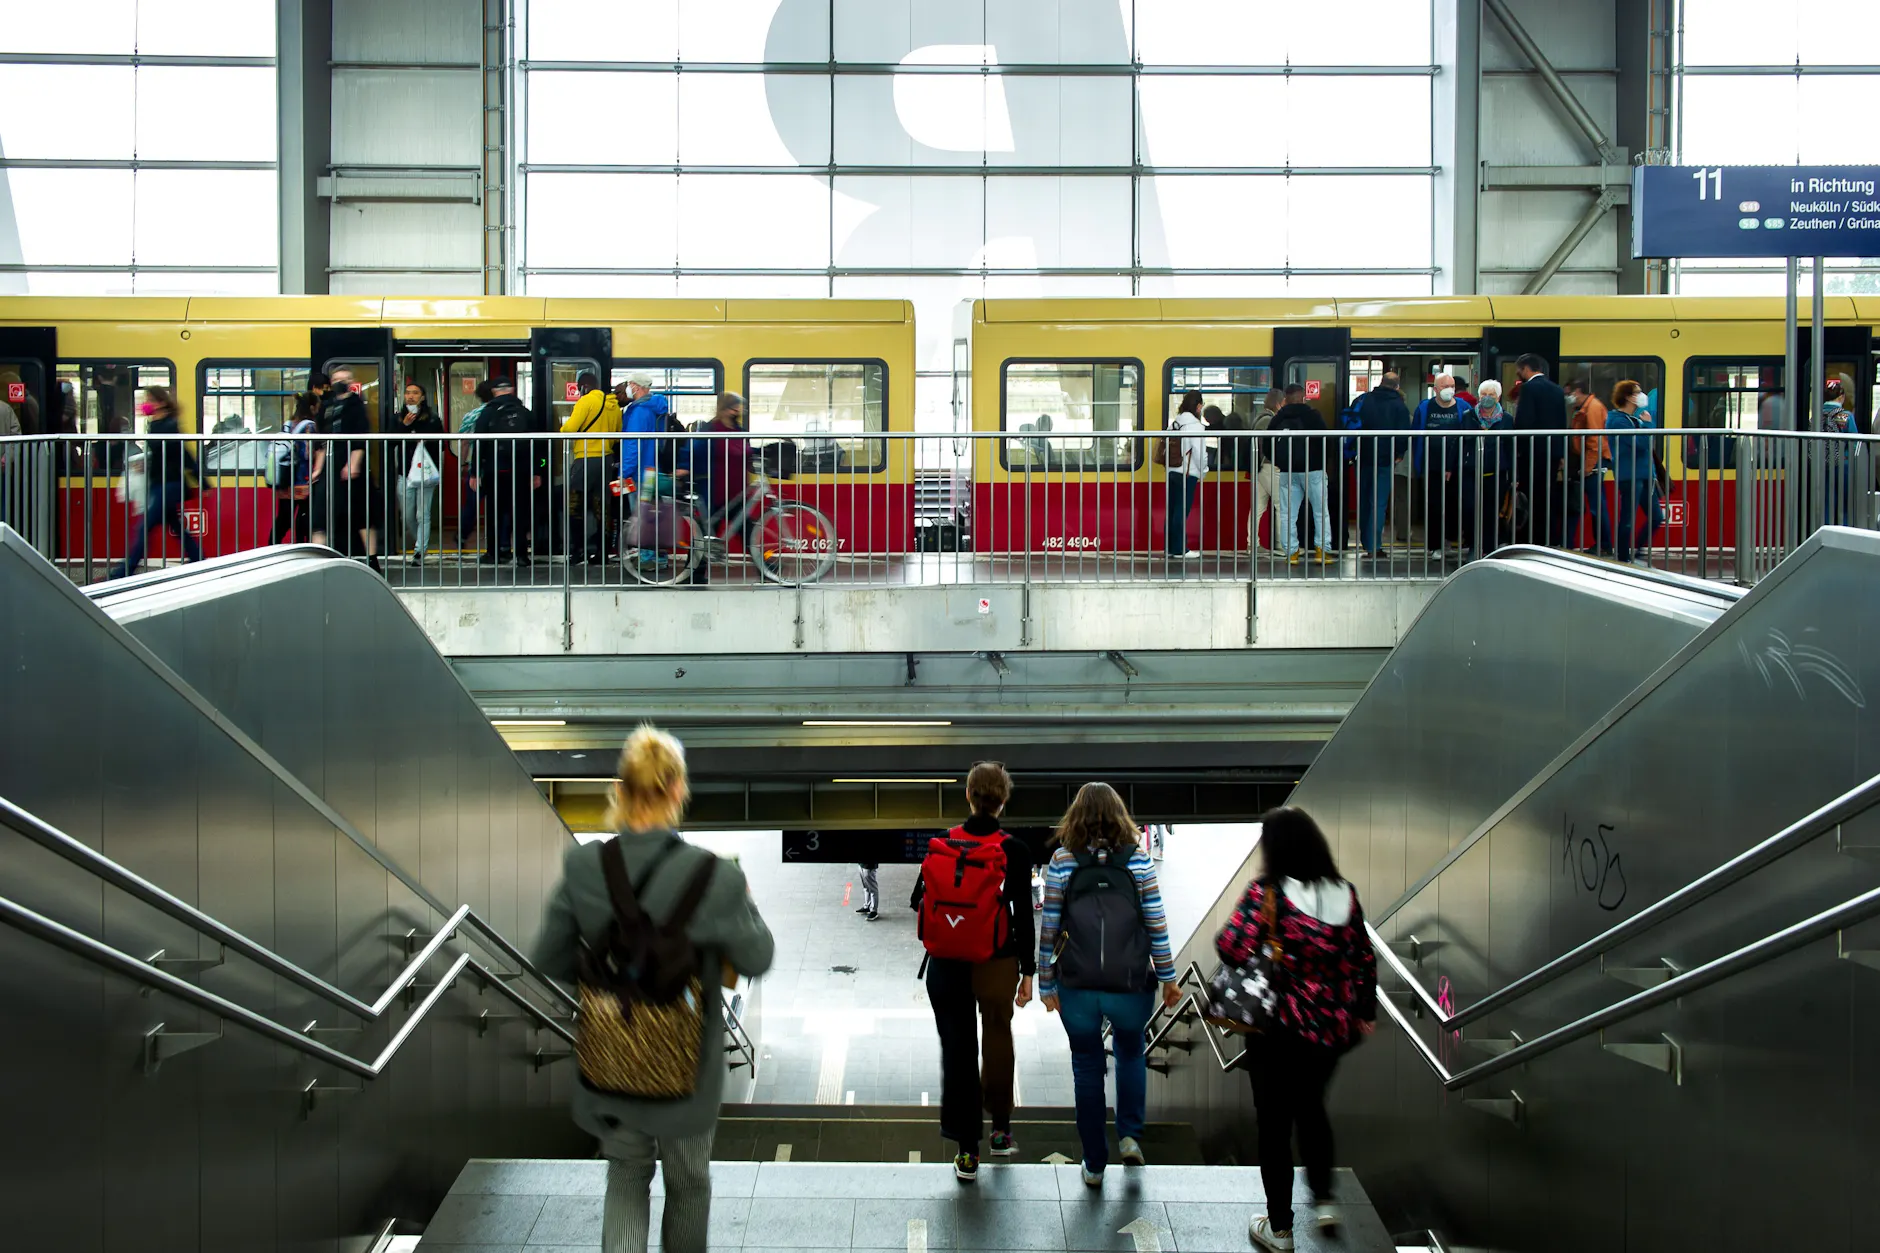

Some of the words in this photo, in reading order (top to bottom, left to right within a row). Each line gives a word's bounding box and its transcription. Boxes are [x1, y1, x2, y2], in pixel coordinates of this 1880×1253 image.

[1692, 168, 1722, 201] 11
[1790, 178, 1804, 193] in
[1809, 177, 1875, 196] Richtung
[1790, 200, 1841, 213] Neukölln
[1843, 200, 1849, 213] /
[1790, 217, 1836, 230] Zeuthen
[1838, 217, 1845, 230] /
[811, 538, 846, 550] 062-7
[1041, 536, 1065, 548] 482
[1066, 536, 1101, 548] 490-0
[805, 830, 821, 851] 3
